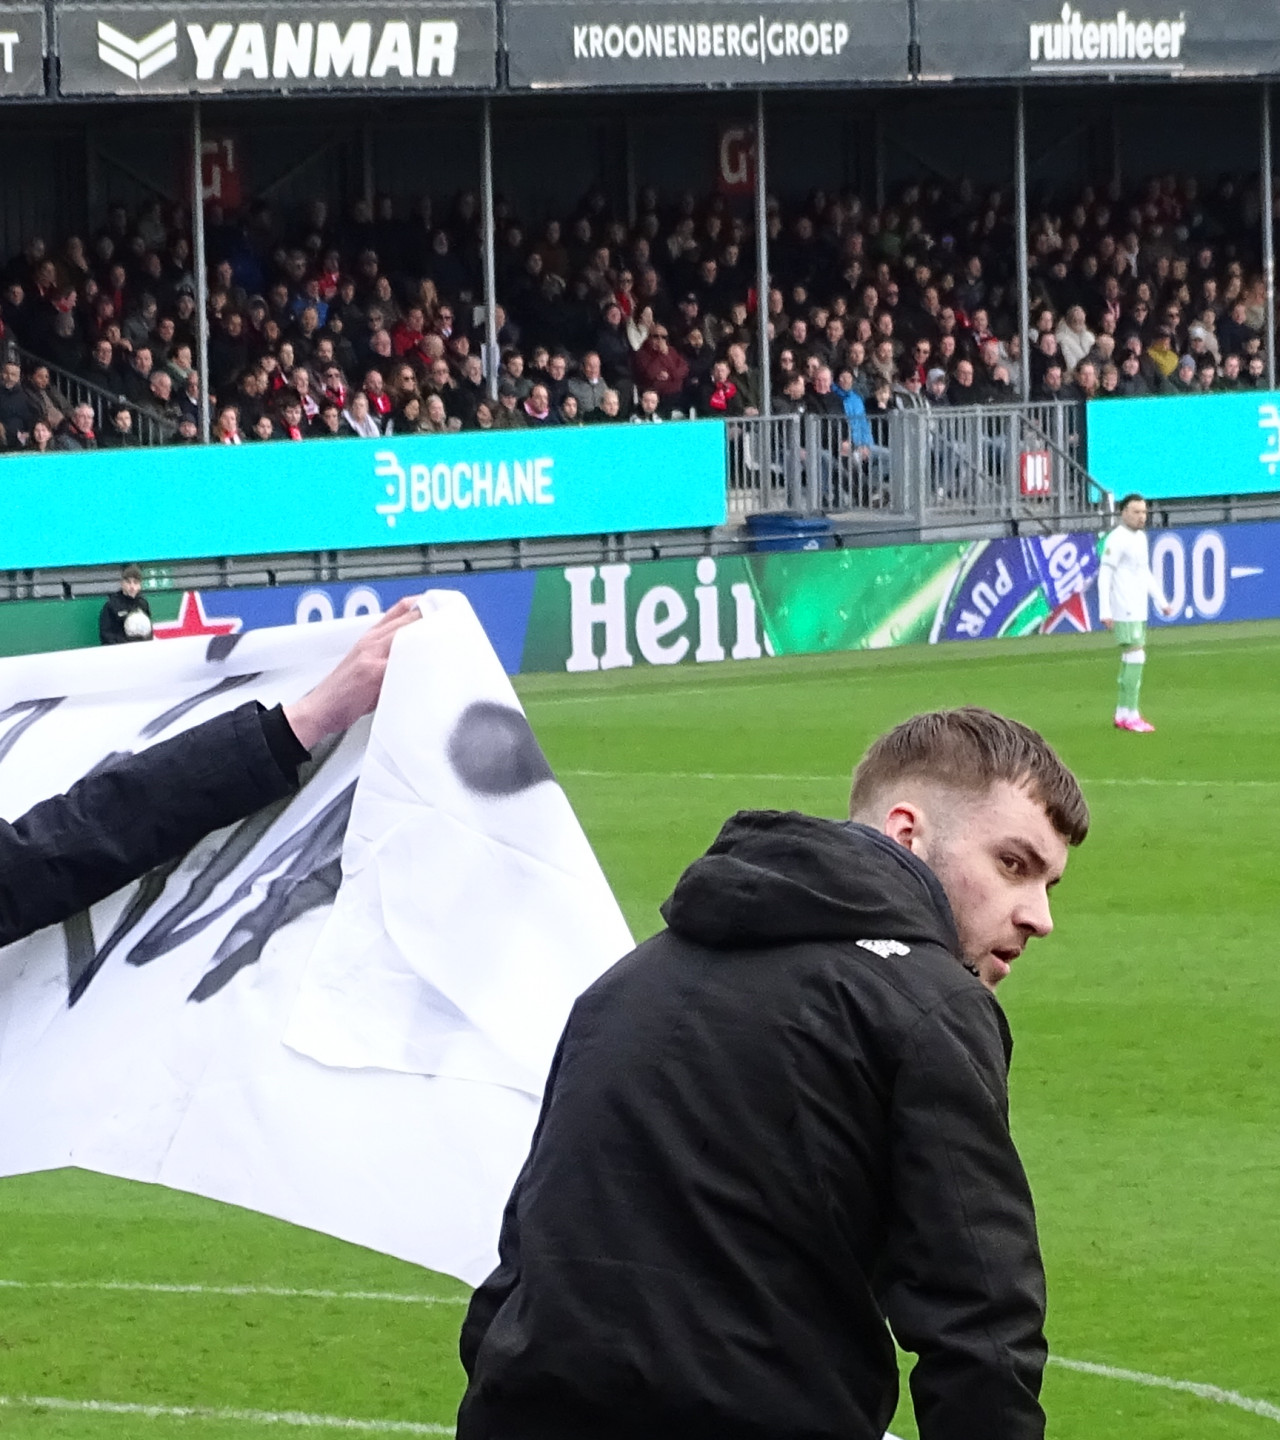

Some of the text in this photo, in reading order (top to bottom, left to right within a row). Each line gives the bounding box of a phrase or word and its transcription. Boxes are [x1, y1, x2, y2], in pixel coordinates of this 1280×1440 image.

[187, 21, 458, 80] YANMAR
[1029, 2, 1186, 60] ruitenheer
[411, 457, 554, 511] BOCHANE
[956, 557, 1013, 637] PUR
[1151, 531, 1225, 618] 0.0
